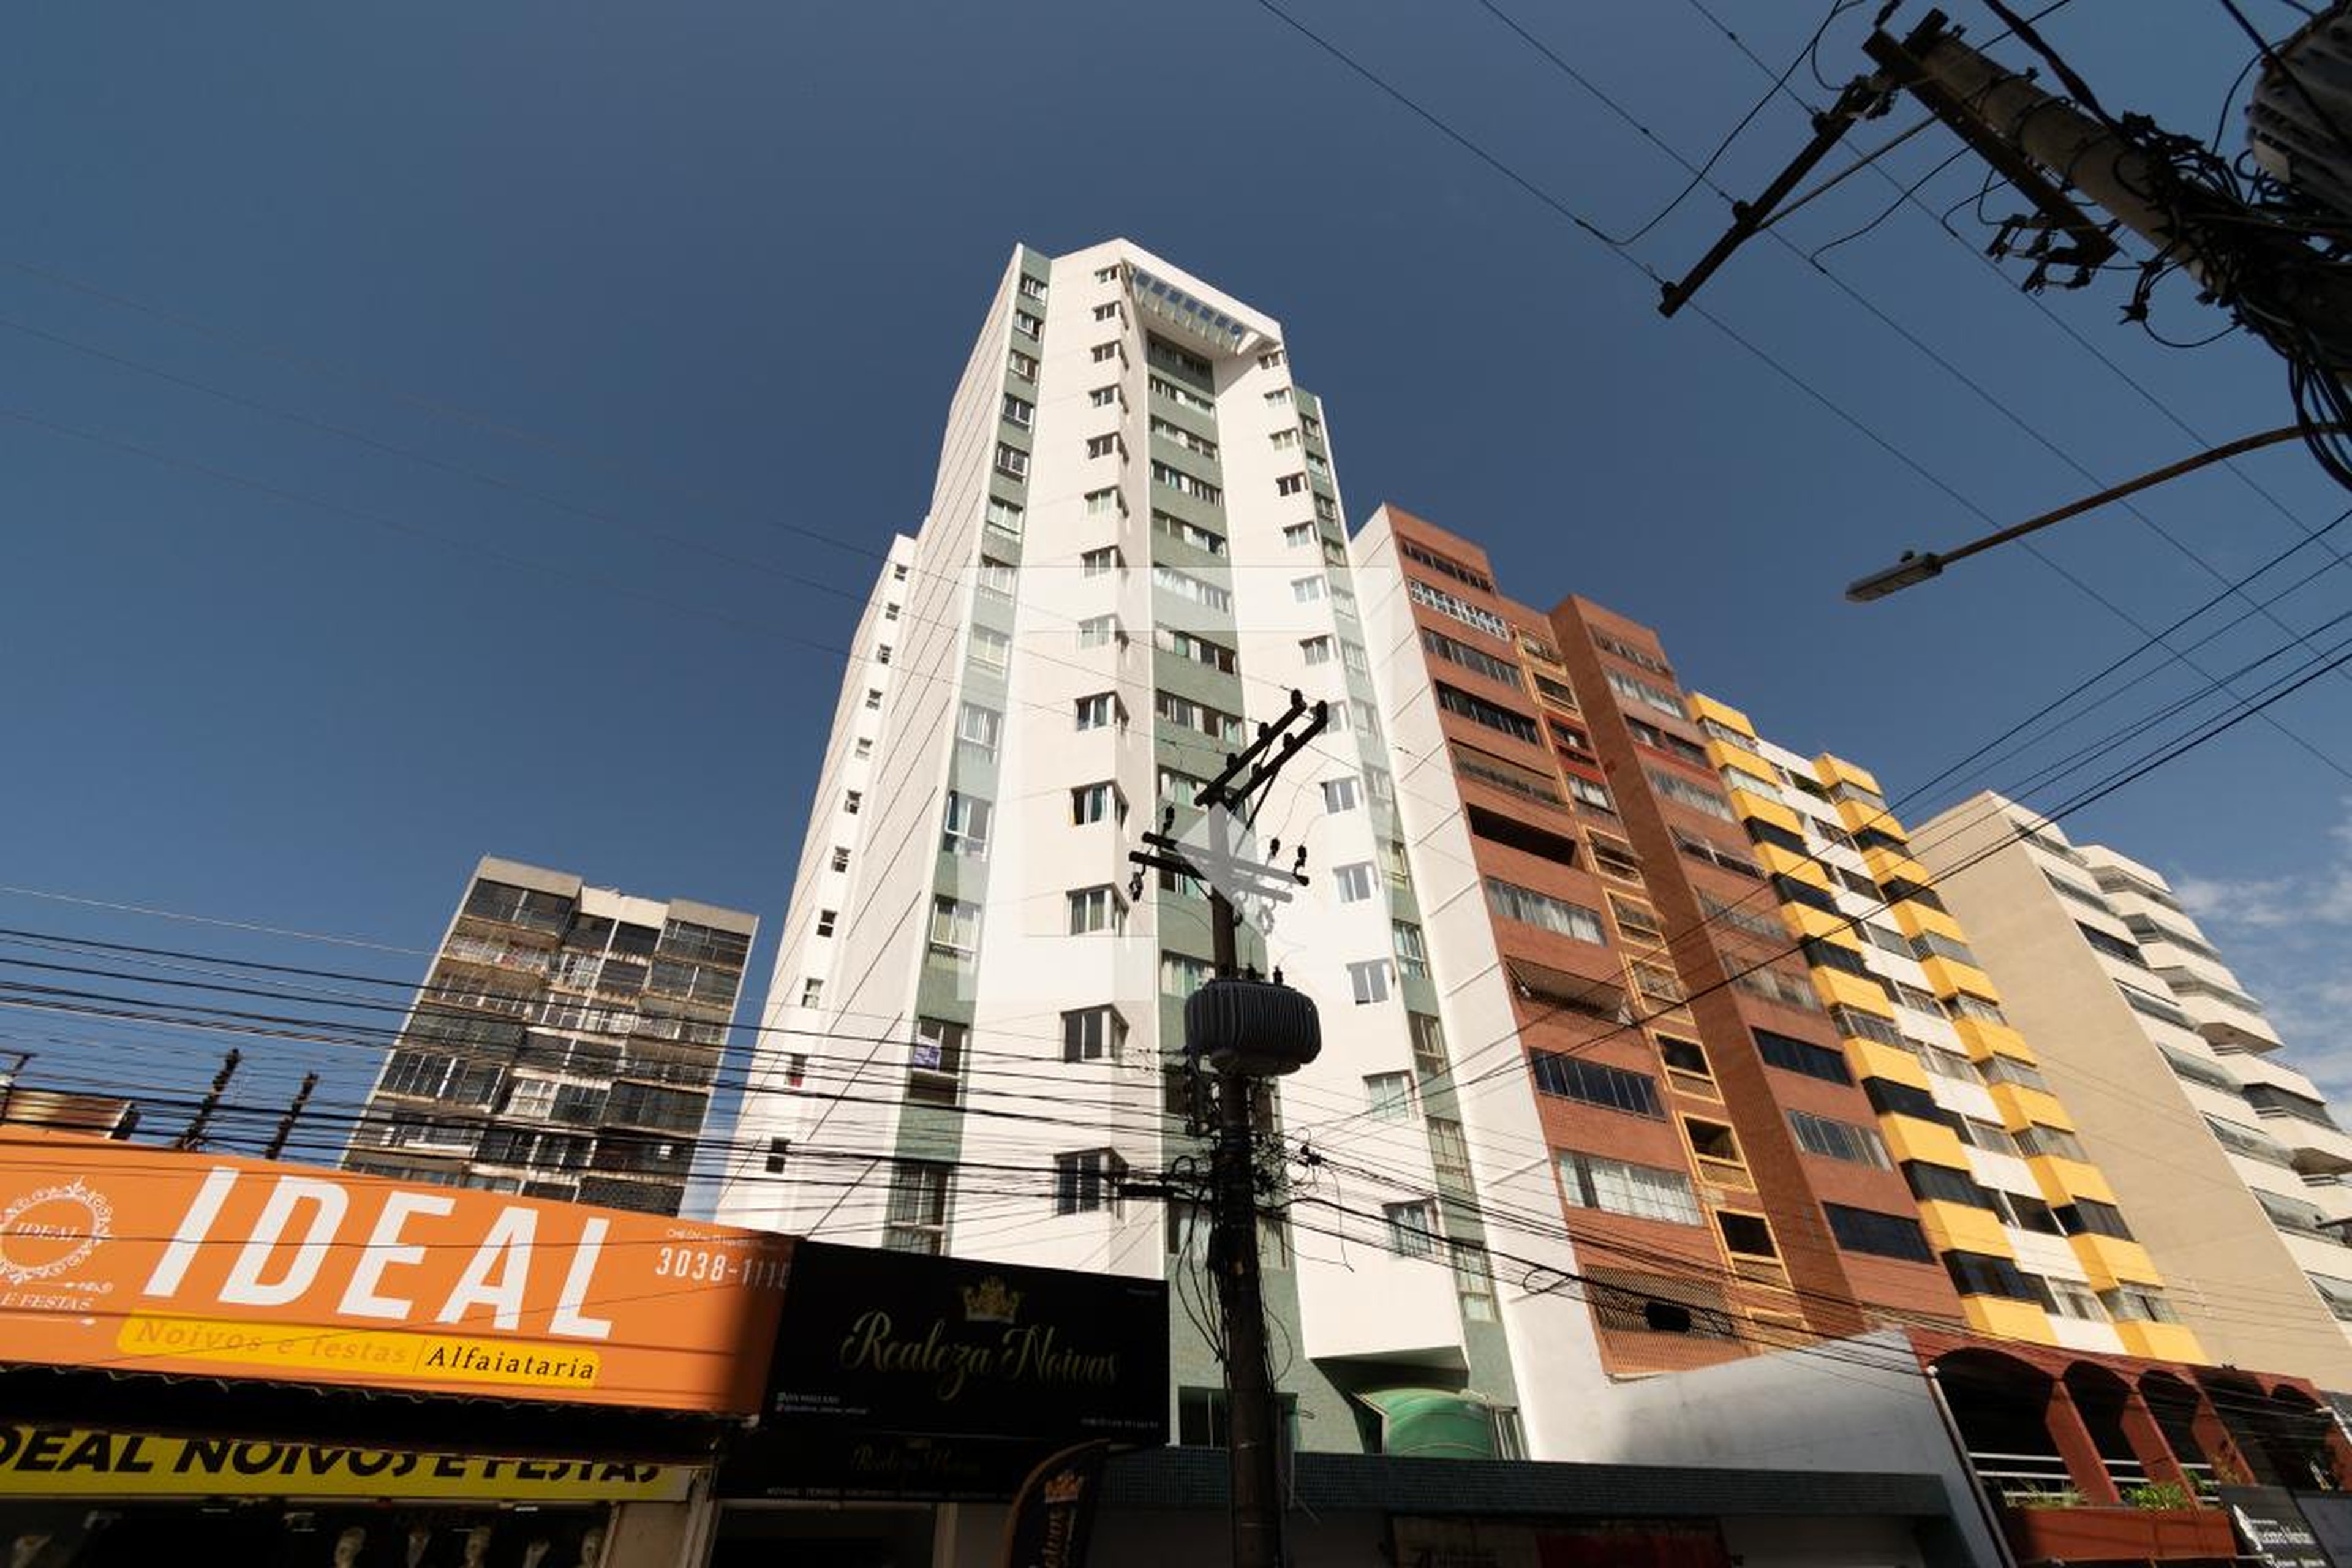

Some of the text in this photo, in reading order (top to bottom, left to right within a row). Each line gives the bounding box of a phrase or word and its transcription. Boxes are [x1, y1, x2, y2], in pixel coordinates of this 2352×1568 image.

[15, 1221, 80, 1242] IDEAL
[143, 1166, 614, 1340] IDEAL
[18, 1294, 94, 1311] FESTAS
[134, 1319, 262, 1353] Noivos
[276, 1338, 295, 1355] e
[425, 1346, 594, 1381] Alfaiataria
[840, 1310, 1120, 1401] Realeza Noivas
